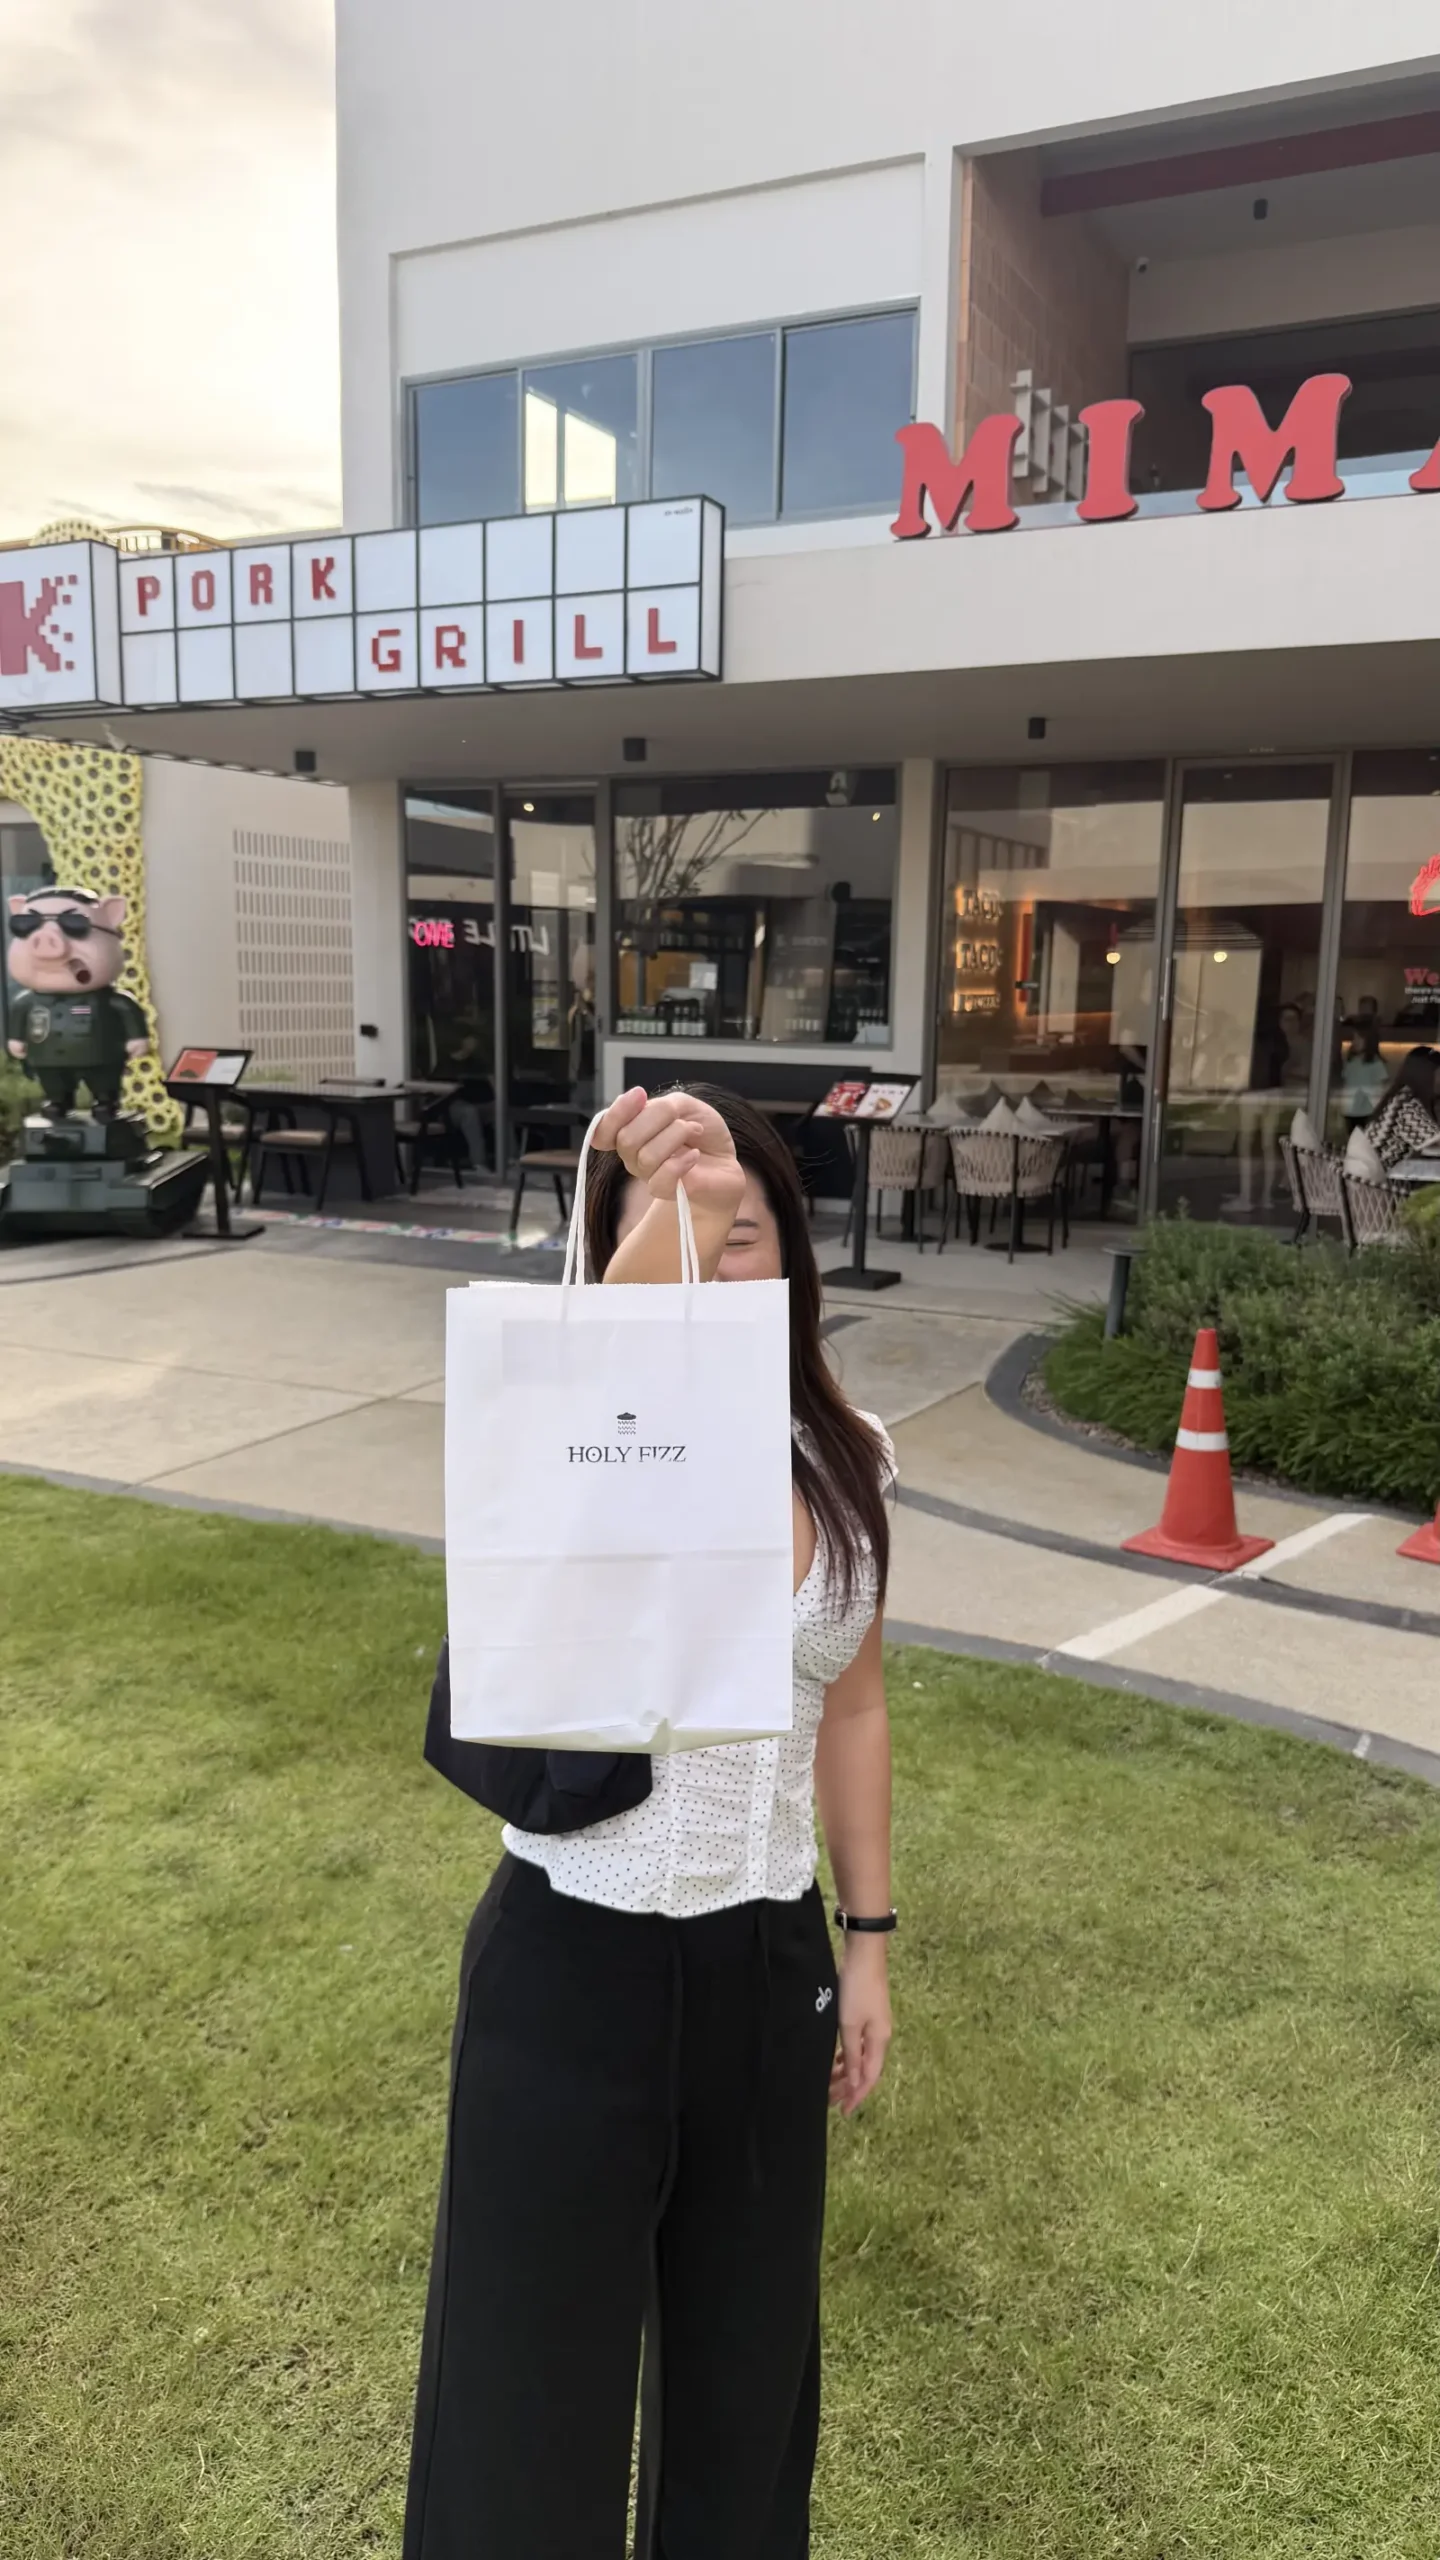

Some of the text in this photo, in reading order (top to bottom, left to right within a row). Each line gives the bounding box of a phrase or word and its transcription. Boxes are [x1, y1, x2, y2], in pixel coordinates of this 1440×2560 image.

[137, 556, 337, 616] PORK
[371, 607, 678, 673] GRILL
[567, 1446, 686, 1463] HOLY FIZZ
